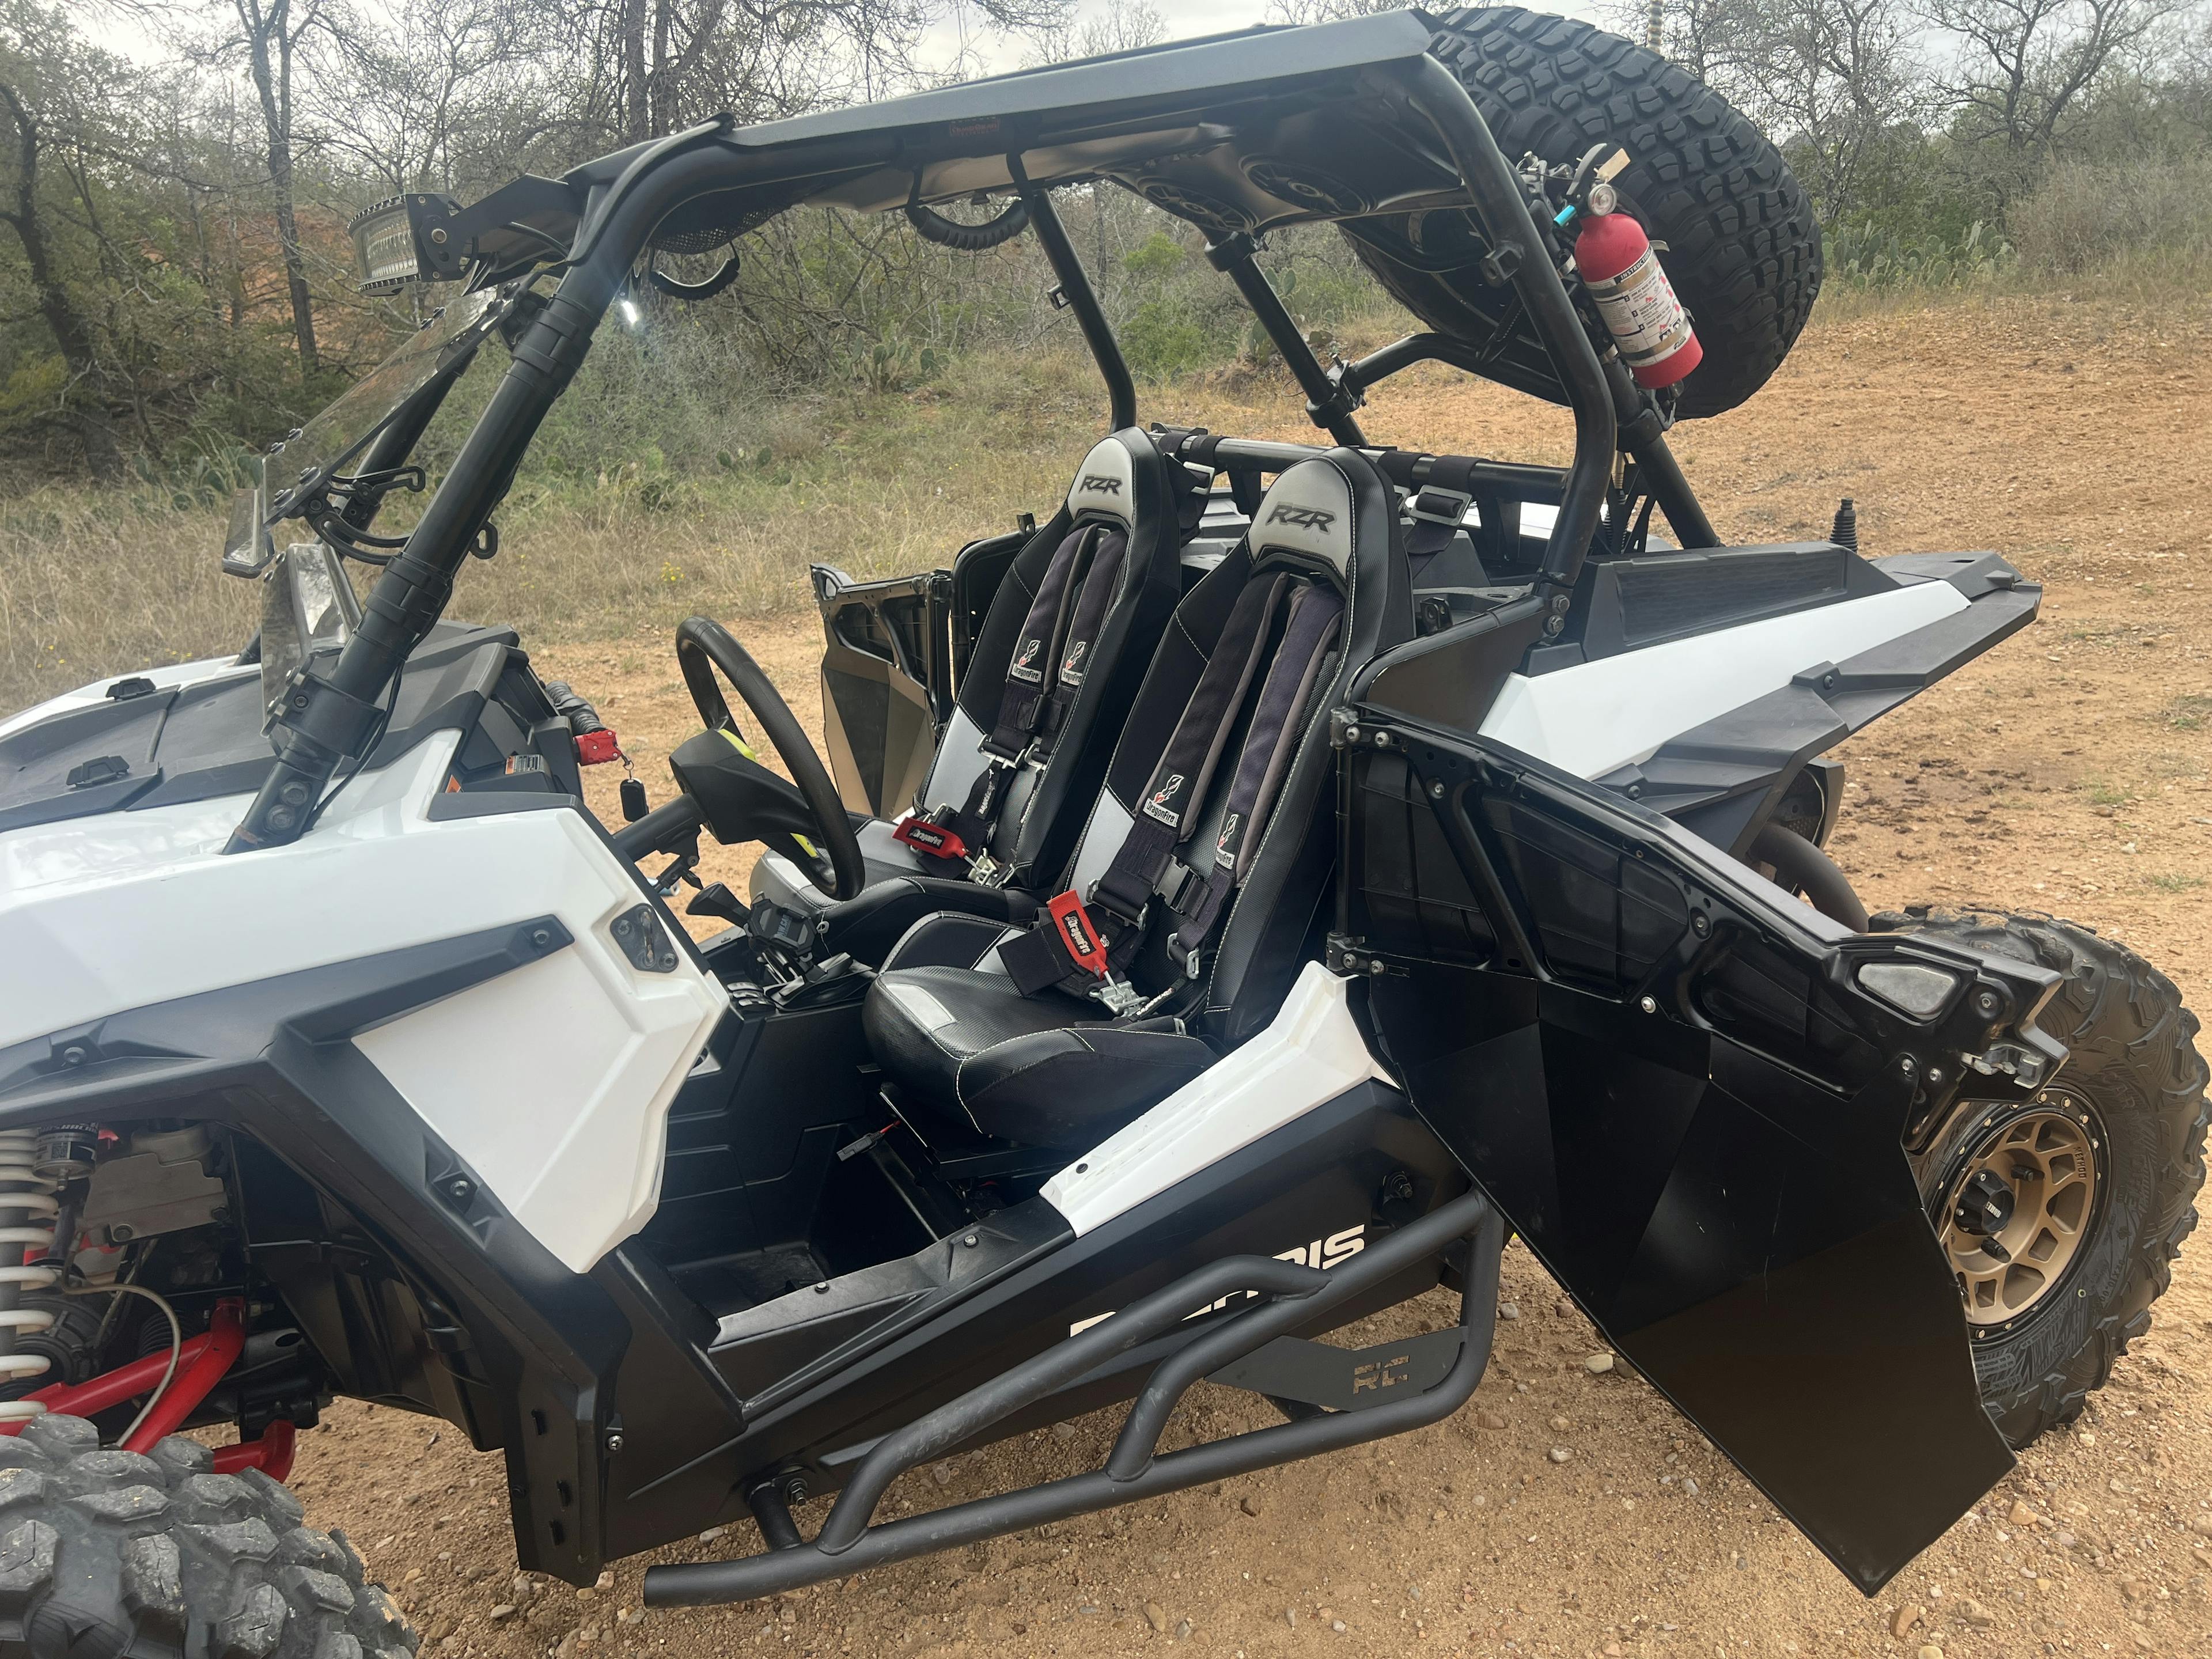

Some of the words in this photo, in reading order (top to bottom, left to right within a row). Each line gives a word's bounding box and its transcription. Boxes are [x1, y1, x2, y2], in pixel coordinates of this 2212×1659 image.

[1079, 475, 1122, 495] RZR
[1266, 503, 1335, 533] RZR
[1147, 801, 1175, 823] DragonFire
[1067, 920, 1091, 953] DragonFire
[2073, 1146, 2087, 1179] METHOD
[1353, 1355, 1410, 1395] RC
